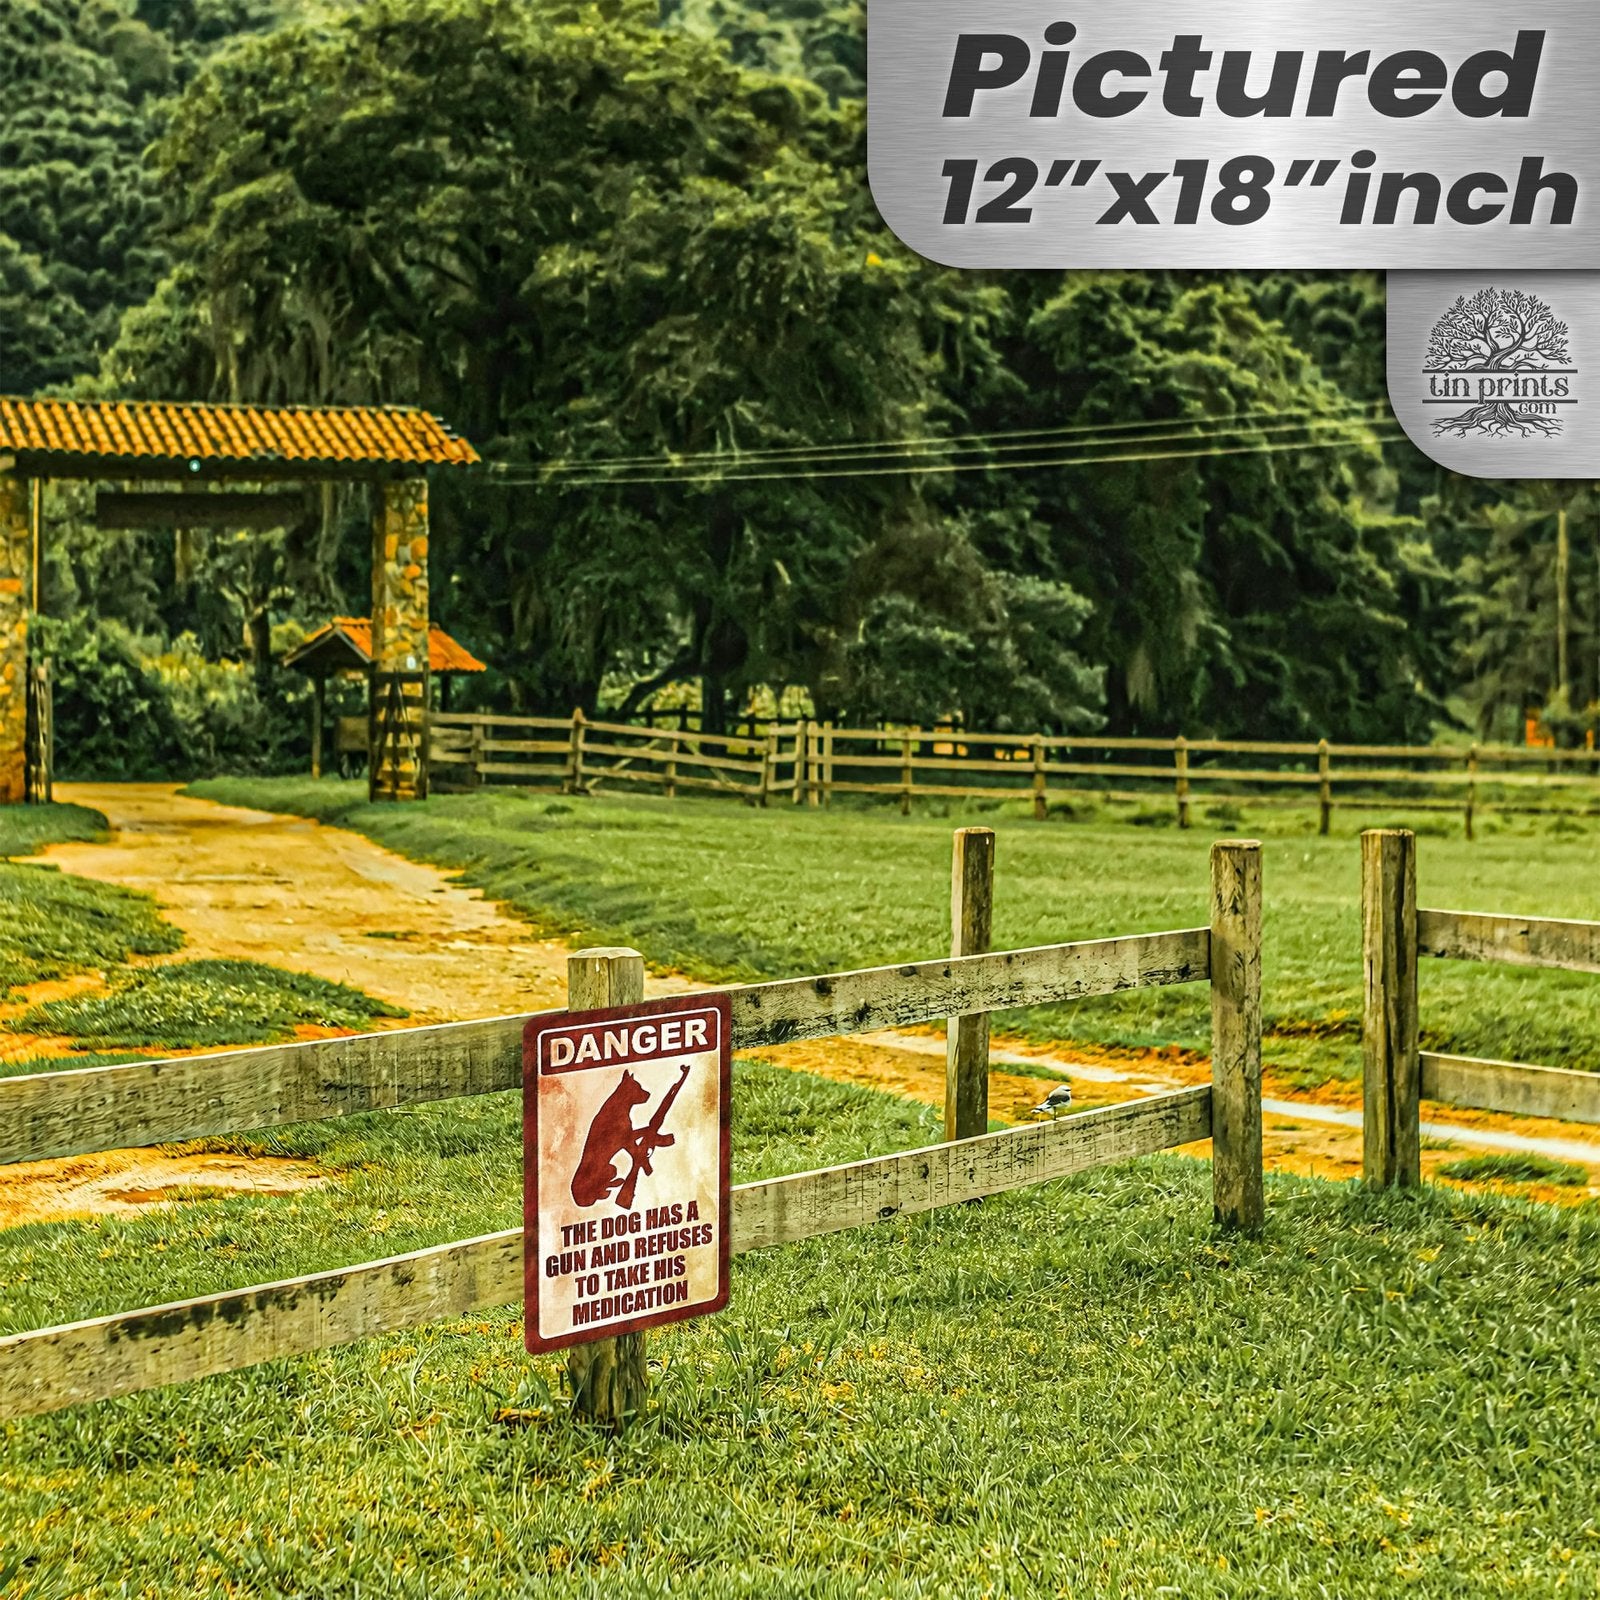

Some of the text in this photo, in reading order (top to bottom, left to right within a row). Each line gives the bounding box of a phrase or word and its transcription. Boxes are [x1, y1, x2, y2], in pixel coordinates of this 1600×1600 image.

[550, 1018, 708, 1067] DANGER
[561, 1200, 699, 1248] THE DOG HAS A
[545, 1223, 713, 1278] GUN AND REFUSES
[575, 1255, 686, 1298] TO TAKE HIS
[572, 1280, 688, 1326] MEDICATION
